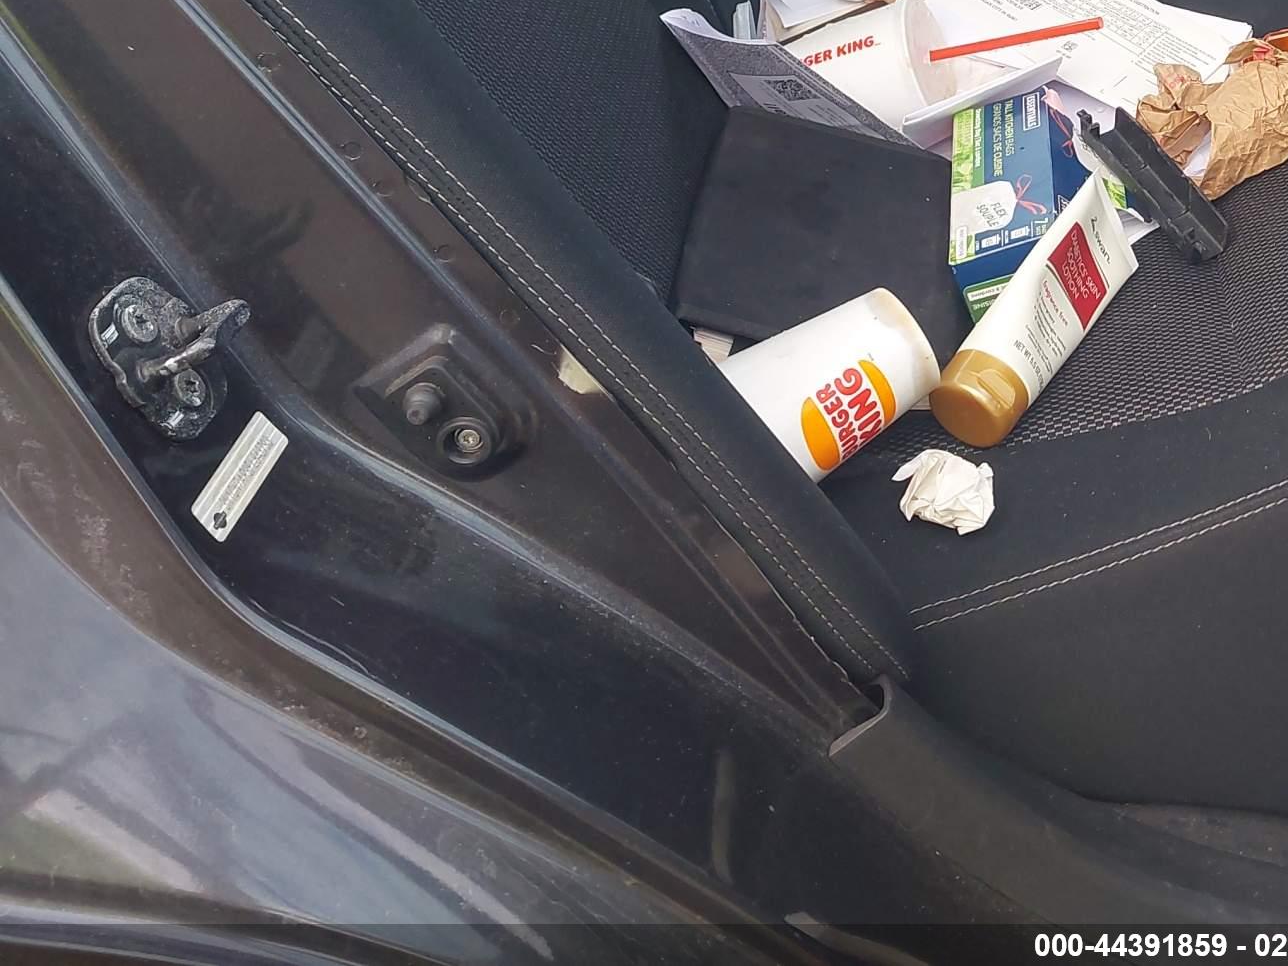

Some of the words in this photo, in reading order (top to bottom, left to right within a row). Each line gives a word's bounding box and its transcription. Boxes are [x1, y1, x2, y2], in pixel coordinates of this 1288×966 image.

[802, 49, 833, 67] GER
[836, 35, 875, 57] KING
[976, 204, 999, 227] SOUPLE
[990, 202, 1008, 217] FLEX
[1095, 232, 1111, 264] swan
[1062, 261, 1080, 299] LOTION
[1066, 247, 1090, 299] SOOTHING
[1085, 276, 1101, 299] SKIN
[816, 383, 859, 460] BURGER
[834, 368, 882, 447] KING
